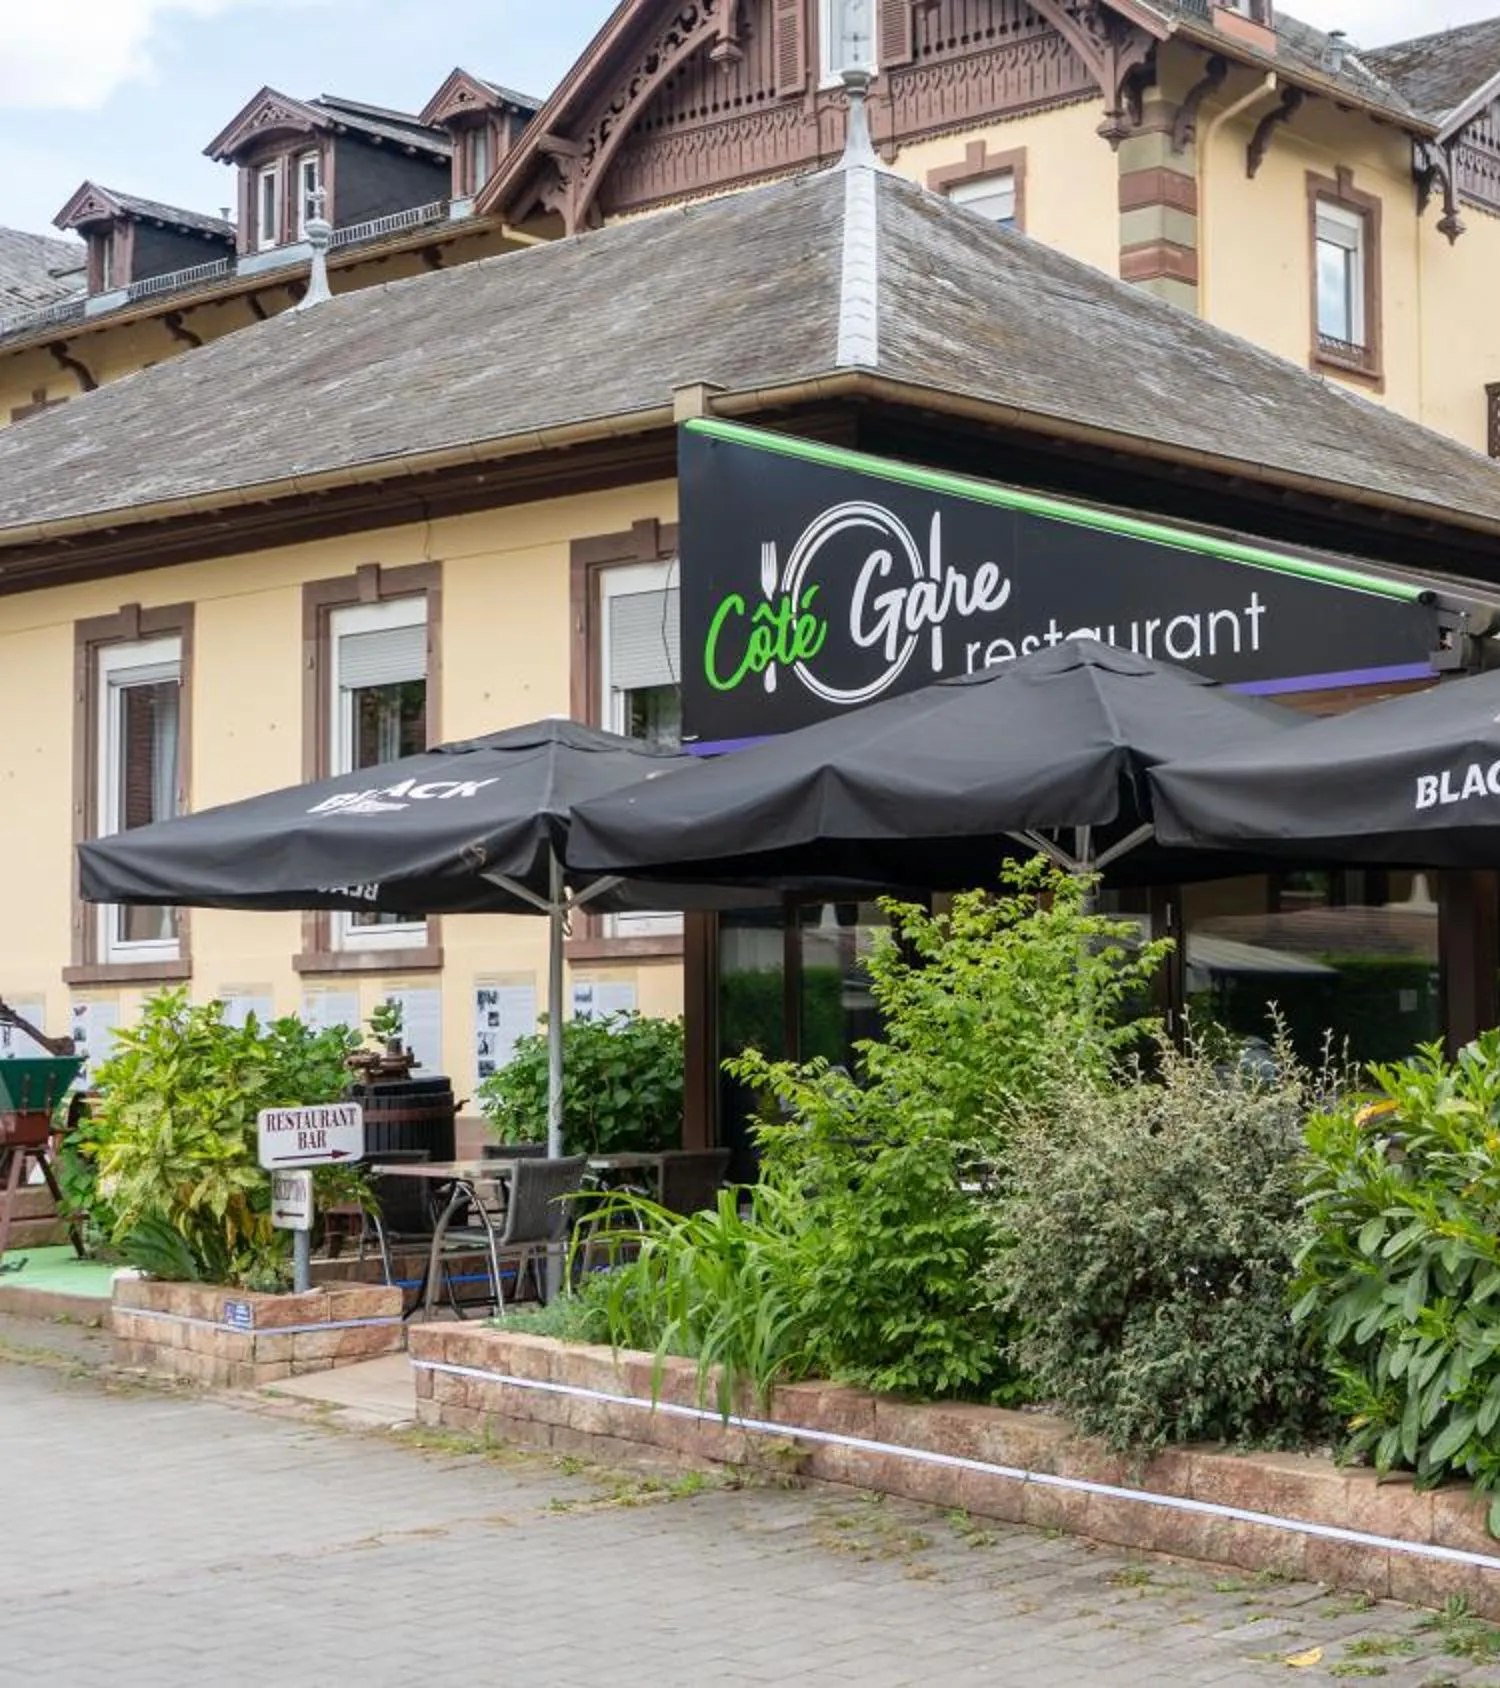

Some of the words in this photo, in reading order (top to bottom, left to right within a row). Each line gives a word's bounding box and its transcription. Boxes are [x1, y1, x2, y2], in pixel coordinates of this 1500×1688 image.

[705, 585, 827, 691] Côté
[850, 549, 1011, 662] Gare
[966, 592, 1267, 675] retrant
[266, 1107, 357, 1132] RESTAURANT
[298, 1130, 327, 1150] BAR
